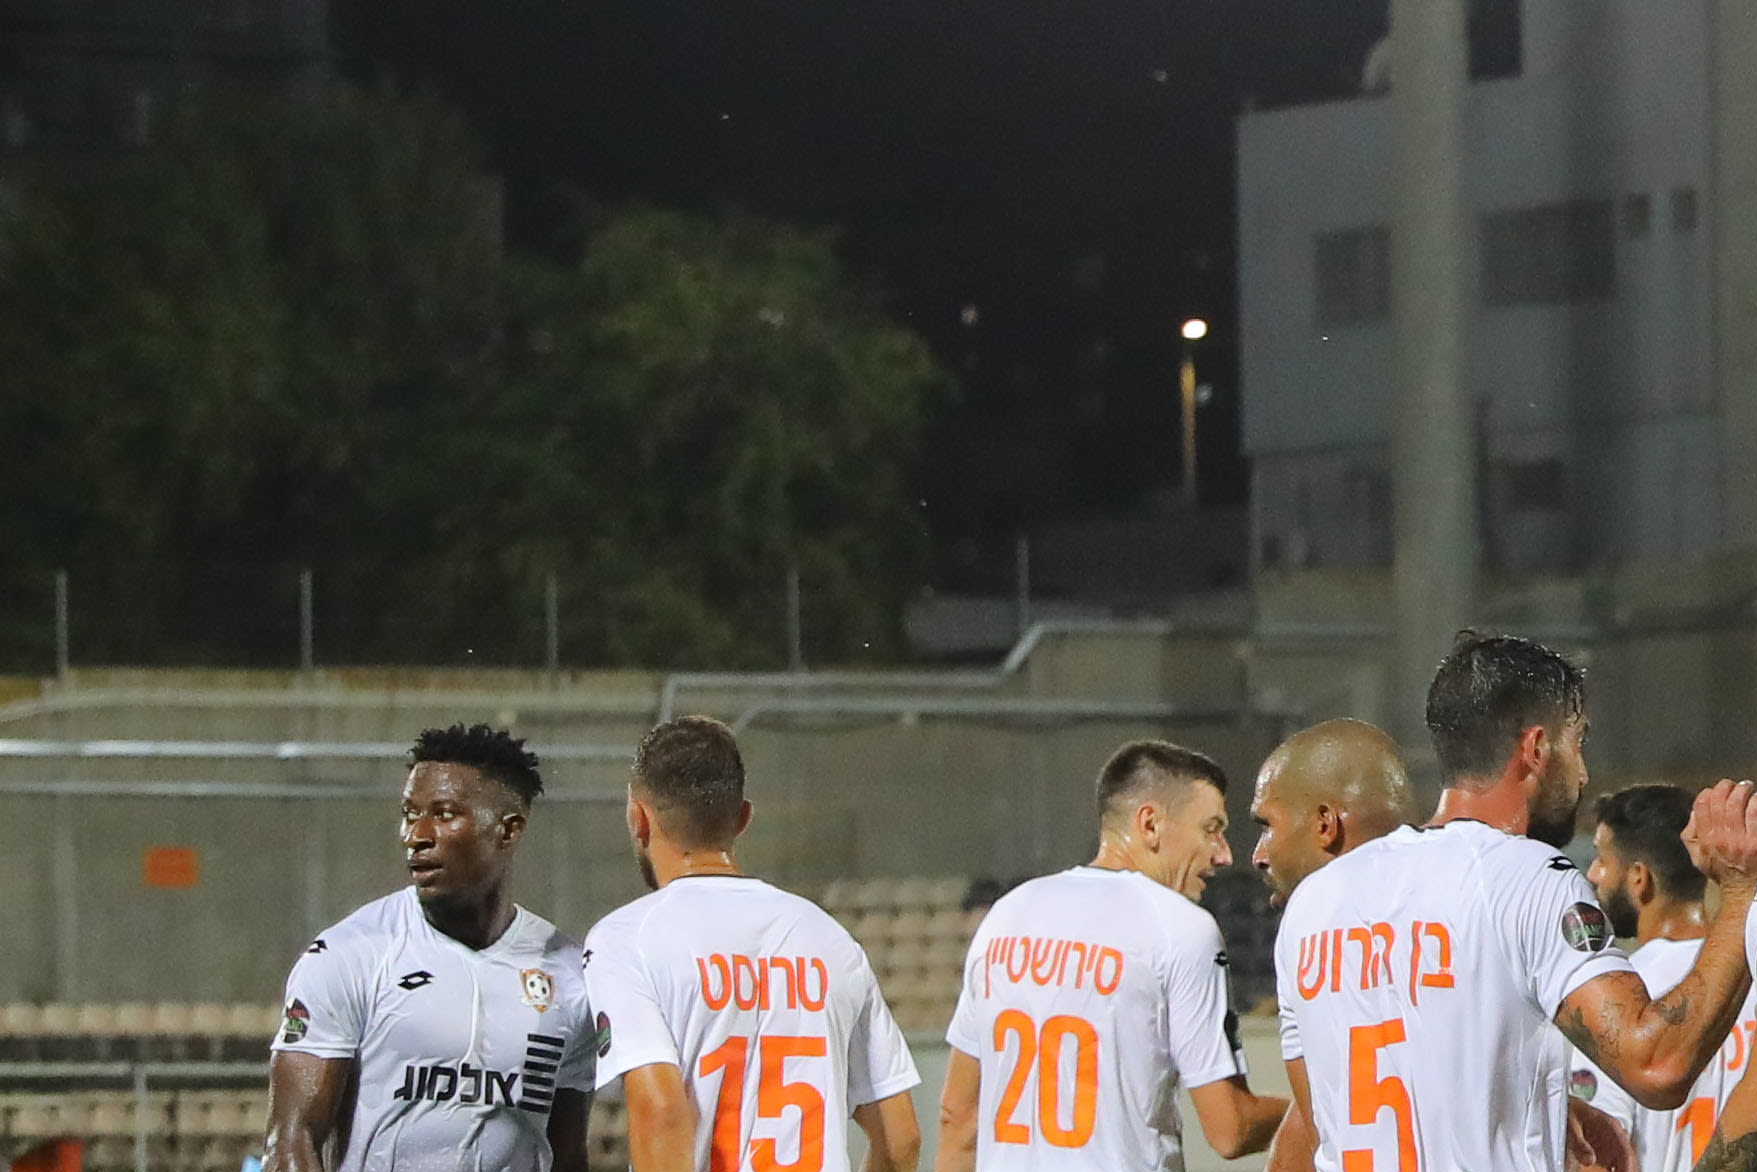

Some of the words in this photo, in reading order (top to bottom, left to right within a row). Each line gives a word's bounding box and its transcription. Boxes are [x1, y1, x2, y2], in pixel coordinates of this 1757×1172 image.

[696, 953, 828, 1012] טרוסט
[985, 936, 1124, 1000] סירושטיין
[1297, 922, 1395, 1000] הרוש
[1409, 920, 1455, 1007] בן
[394, 1063, 520, 1108] אלמוג
[993, 1009, 1098, 1149] 20
